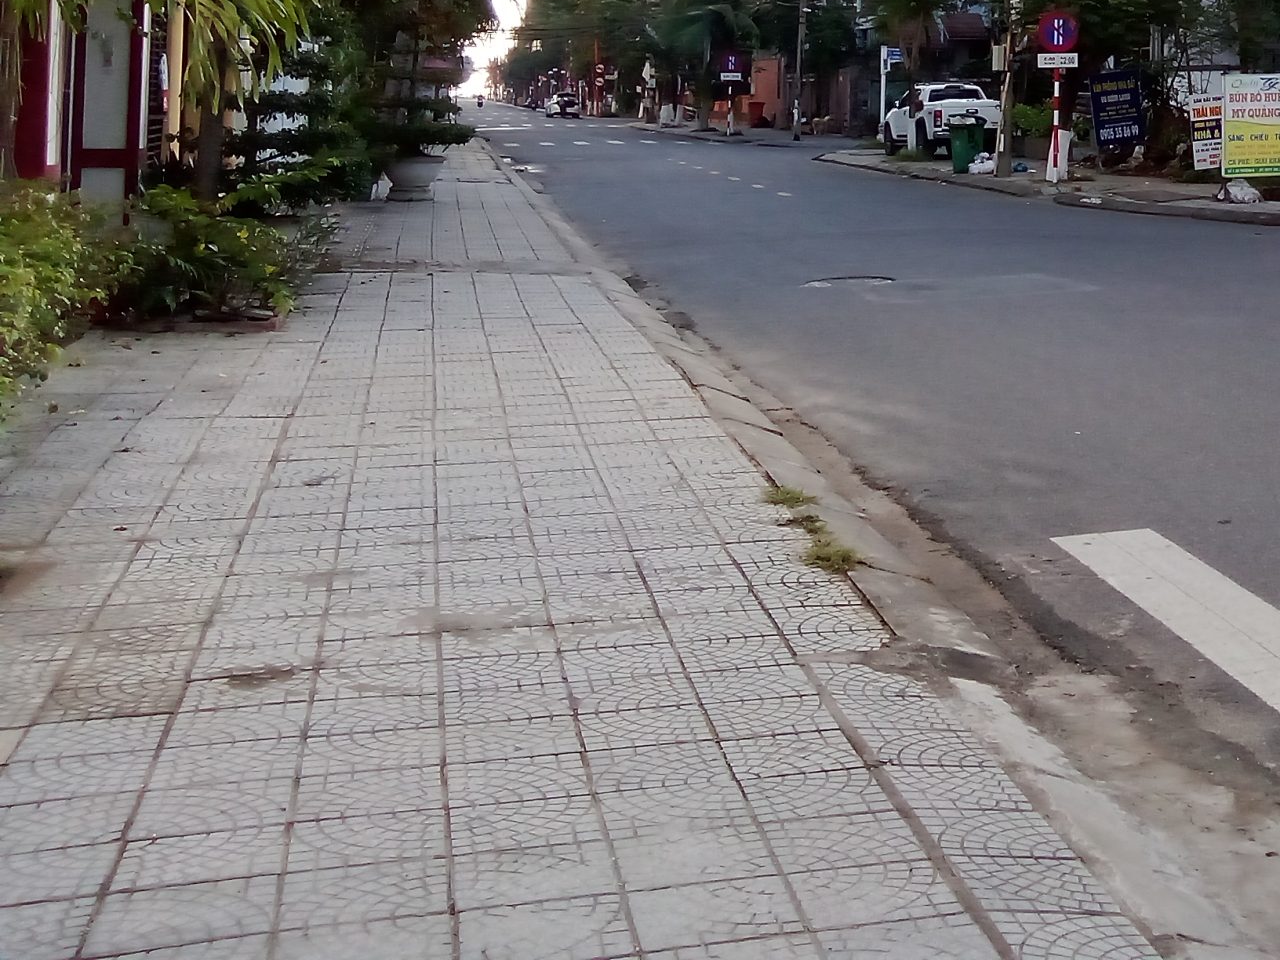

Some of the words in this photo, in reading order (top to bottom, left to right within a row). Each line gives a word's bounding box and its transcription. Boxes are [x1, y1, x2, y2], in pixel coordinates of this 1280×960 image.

[1229, 90, 1248, 103] BÚN
[1250, 90, 1262, 102] BÒ
[1192, 105, 1207, 118] THÁI
[1247, 105, 1280, 118] QUẢNG
